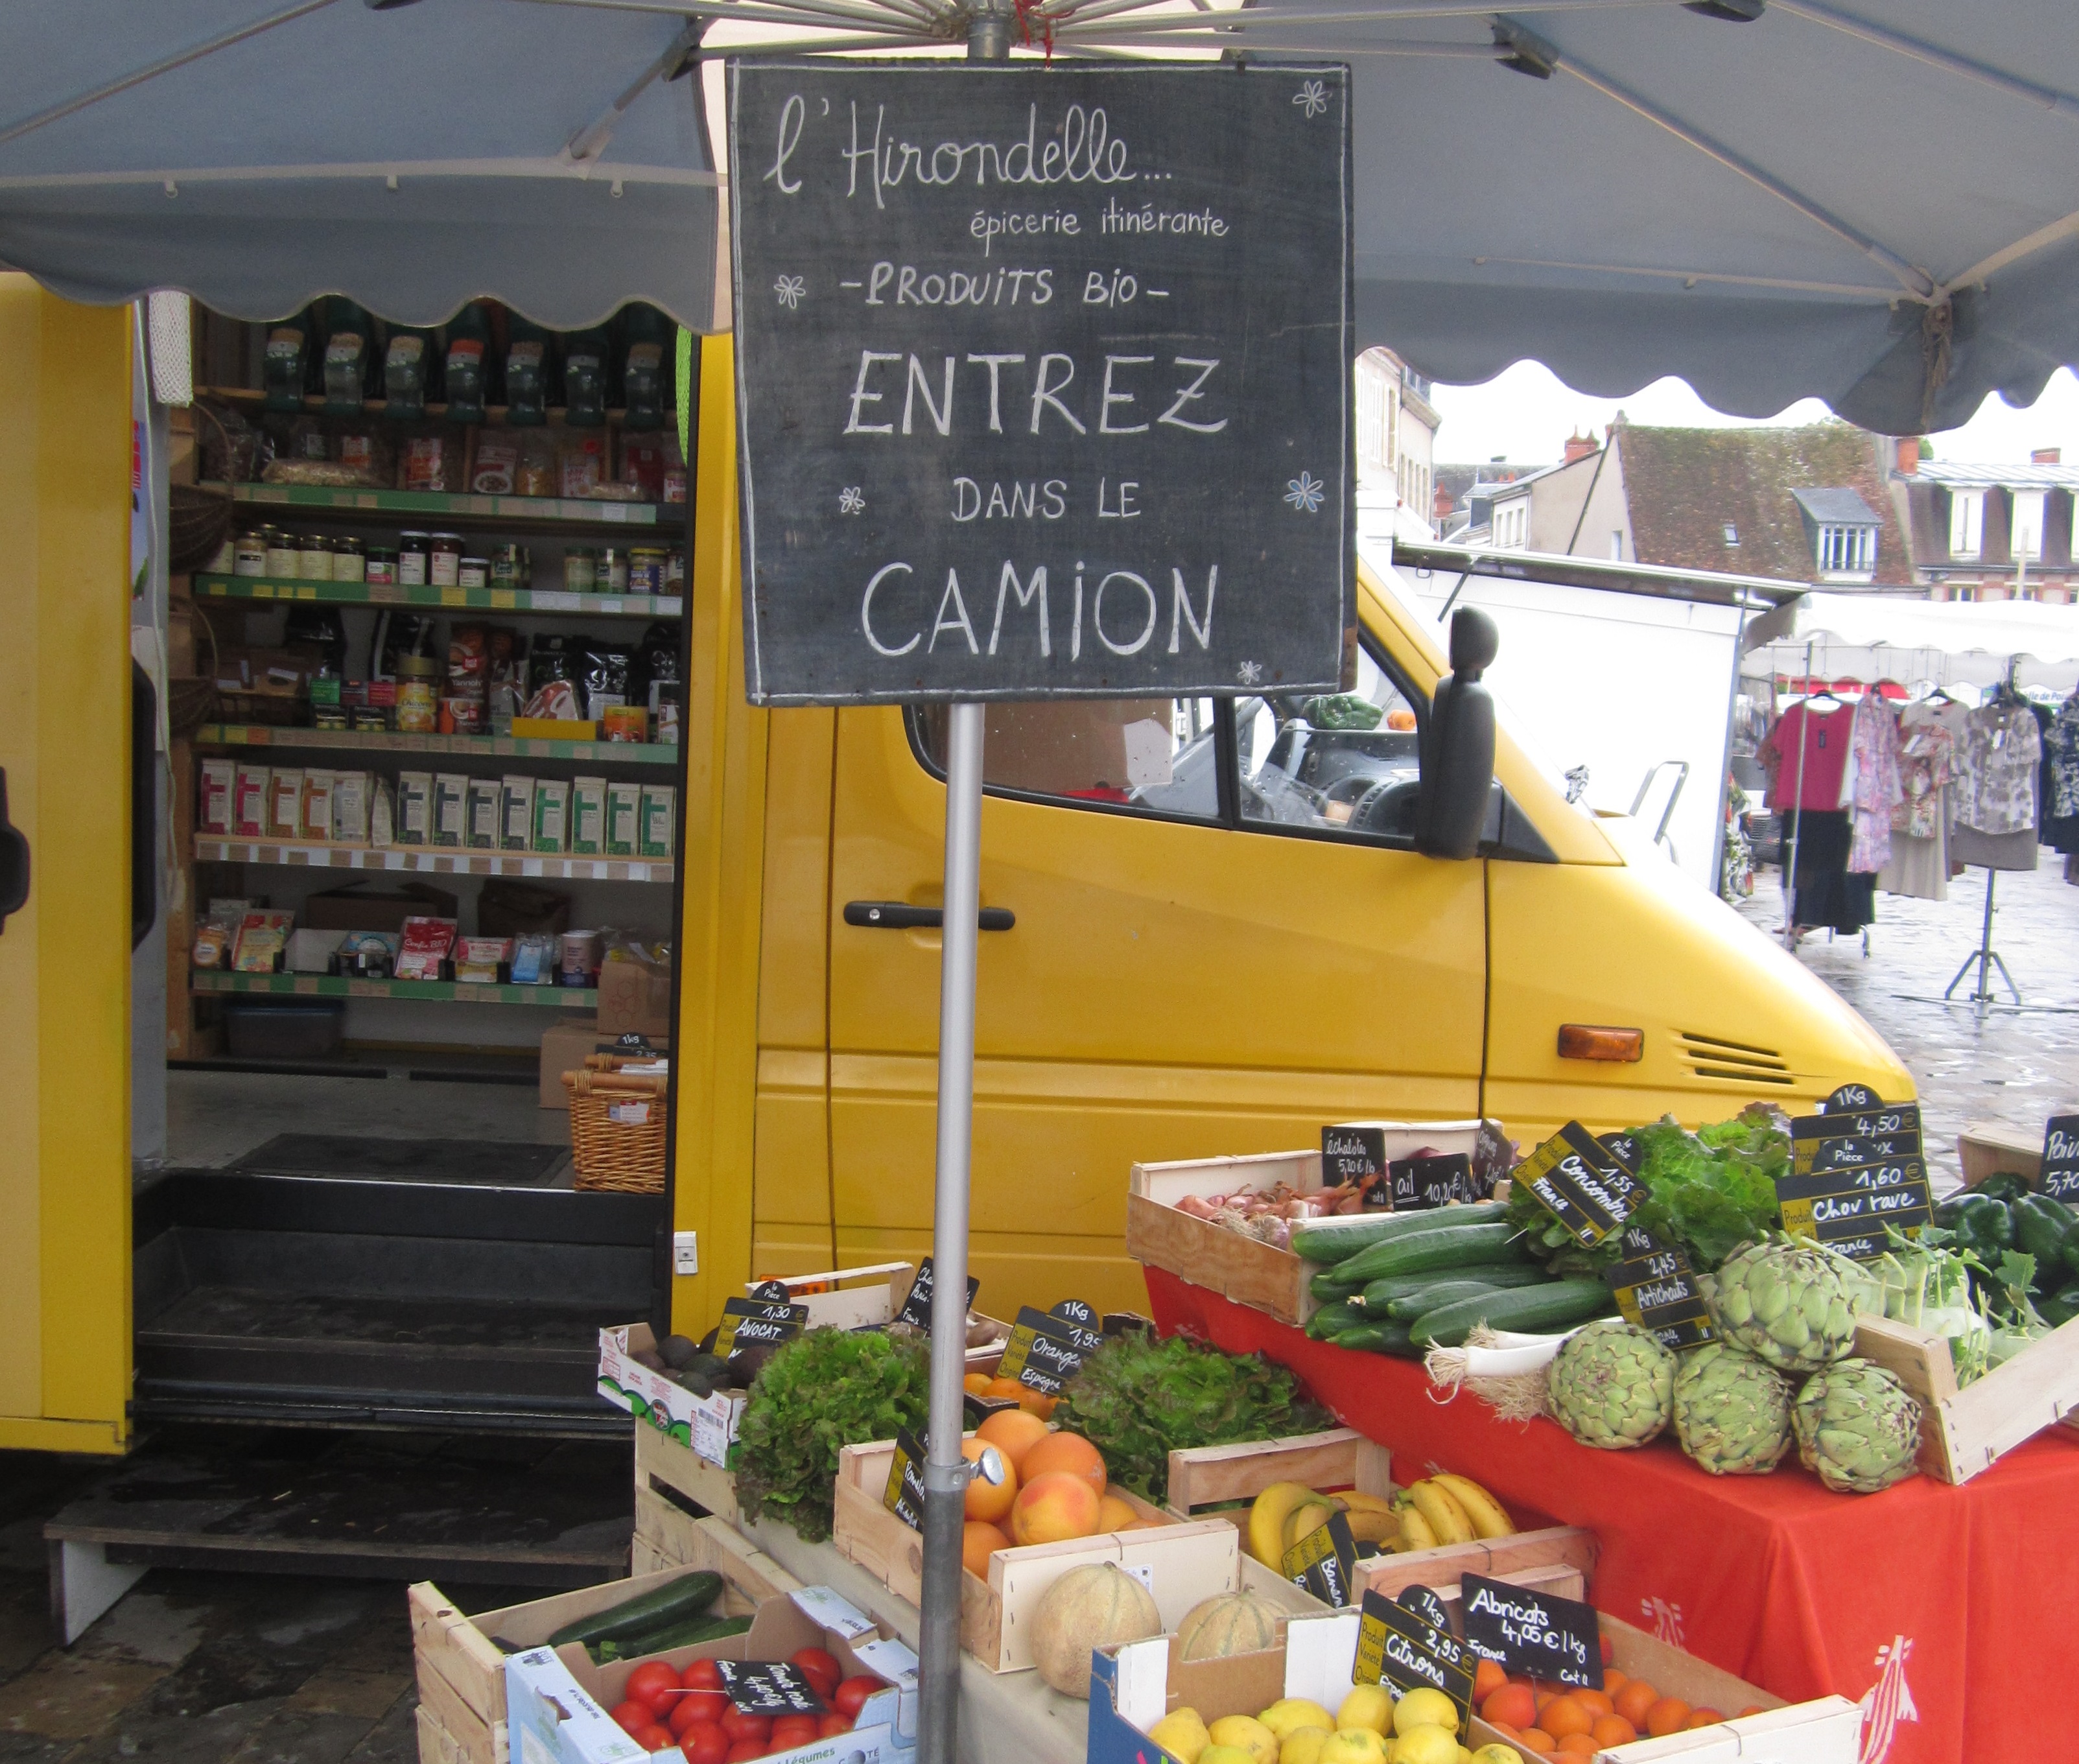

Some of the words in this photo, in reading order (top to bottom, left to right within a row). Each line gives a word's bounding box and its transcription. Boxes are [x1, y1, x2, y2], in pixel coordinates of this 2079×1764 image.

[970, 209, 1081, 257] épicerie
[1100, 197, 1230, 237] itinérante
[841, 349, 1230, 436] ENTREZ
[951, 476, 1068, 523] DANS
[1099, 476, 1142, 519] LE
[1836, 1086, 1867, 1107] 1Kg
[1857, 1114, 1900, 1138] 4,50
[1834, 1149, 1863, 1162] Pièce
[1845, 1138, 1854, 1151] la
[1397, 1168, 1415, 1196] ail
[1560, 1155, 1628, 1222] Concombre
[1599, 1167, 1635, 1194] 1,55
[1855, 1167, 1901, 1191] 1,60
[1532, 1176, 1569, 1212] France
[1870, 1192, 1916, 1212] rave
[1627, 1228, 1651, 1249] 1Kg
[1649, 1252, 1676, 1279] 2,45
[1636, 1275, 1689, 1310] Artichauts
[762, 1305, 790, 1321] 1,30
[1064, 1301, 1089, 1321] 1Kg
[734, 1317, 782, 1341] AVOCAT
[1013, 1329, 1033, 1348] Produit
[1032, 1337, 1081, 1372] Oranges
[1021, 1367, 1061, 1393] Espagne
[1469, 1588, 1549, 1627] Abricots
[1362, 1622, 1384, 1647] Produit
[1386, 1633, 1444, 1688] Citrons
[1426, 1629, 1461, 1663] 2,95
